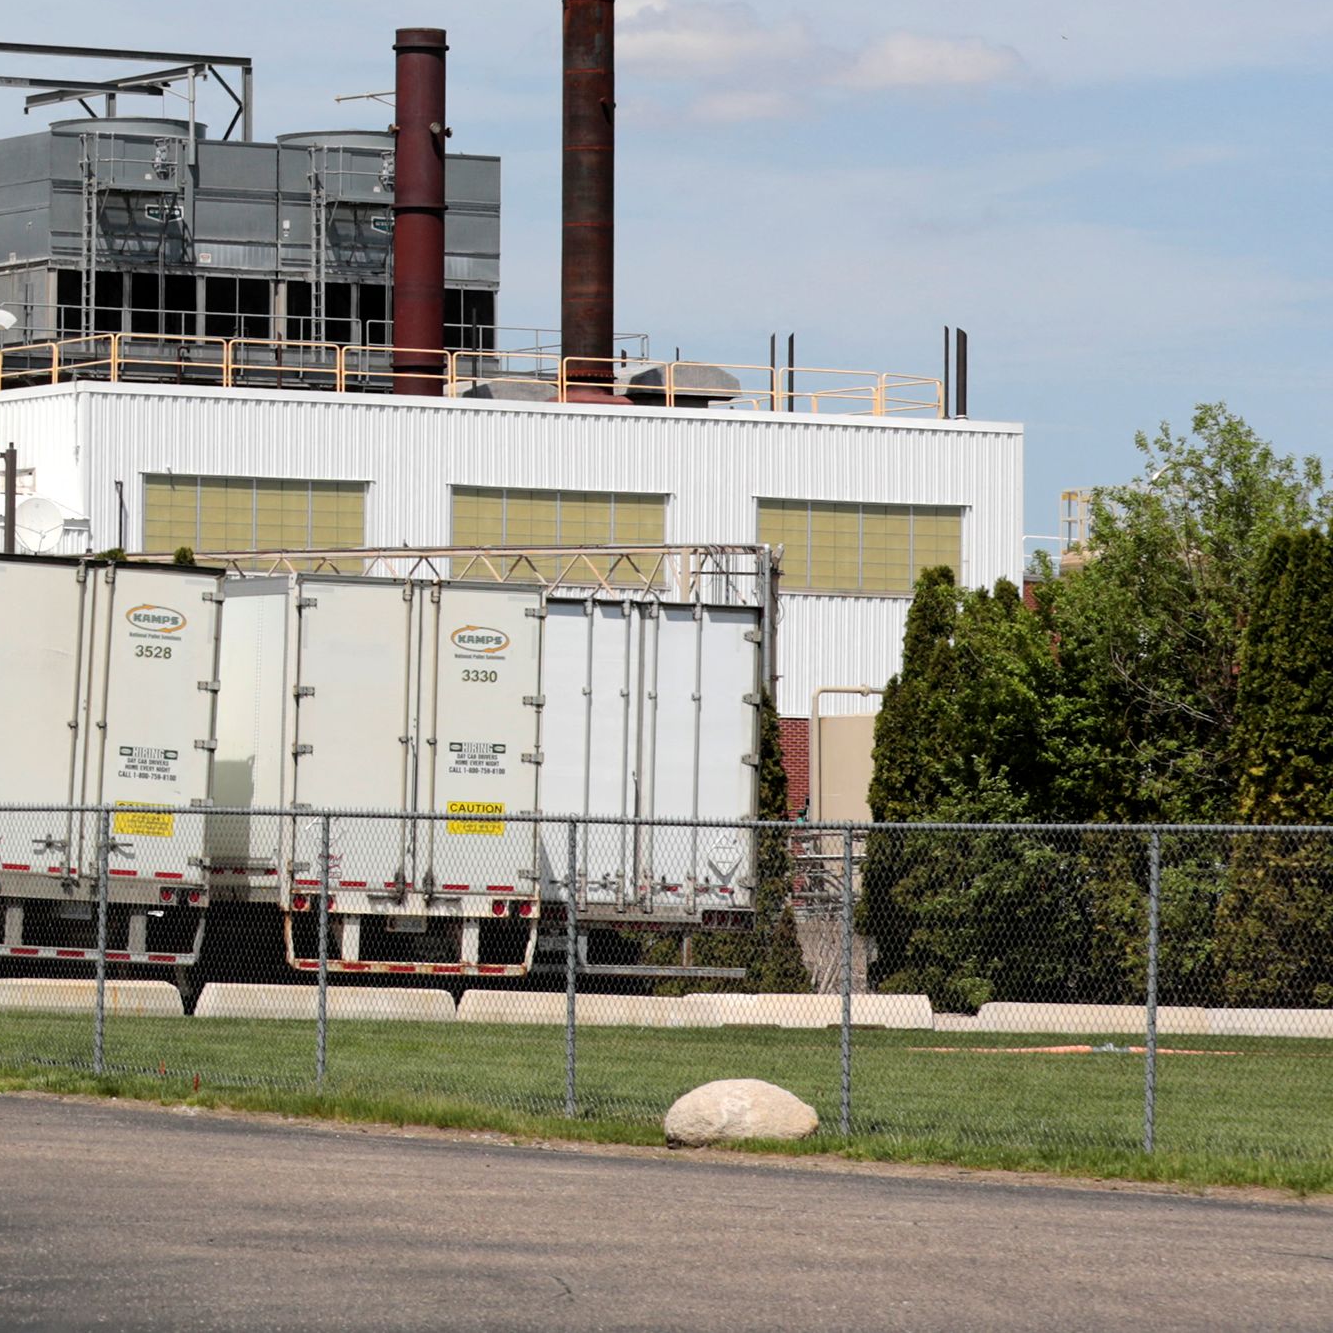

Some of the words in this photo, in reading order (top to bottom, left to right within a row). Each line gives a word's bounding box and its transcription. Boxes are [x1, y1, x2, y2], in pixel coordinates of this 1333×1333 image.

[133, 613, 179, 625] KAMPS
[458, 634, 503, 645] KAMPS
[135, 645, 172, 659] 3528
[462, 669, 498, 683] 3330
[134, 747, 164, 759] HIRING
[463, 742, 493, 753] HIRING
[118, 770, 132, 778] CALL
[450, 803, 503, 814] CAUTION
